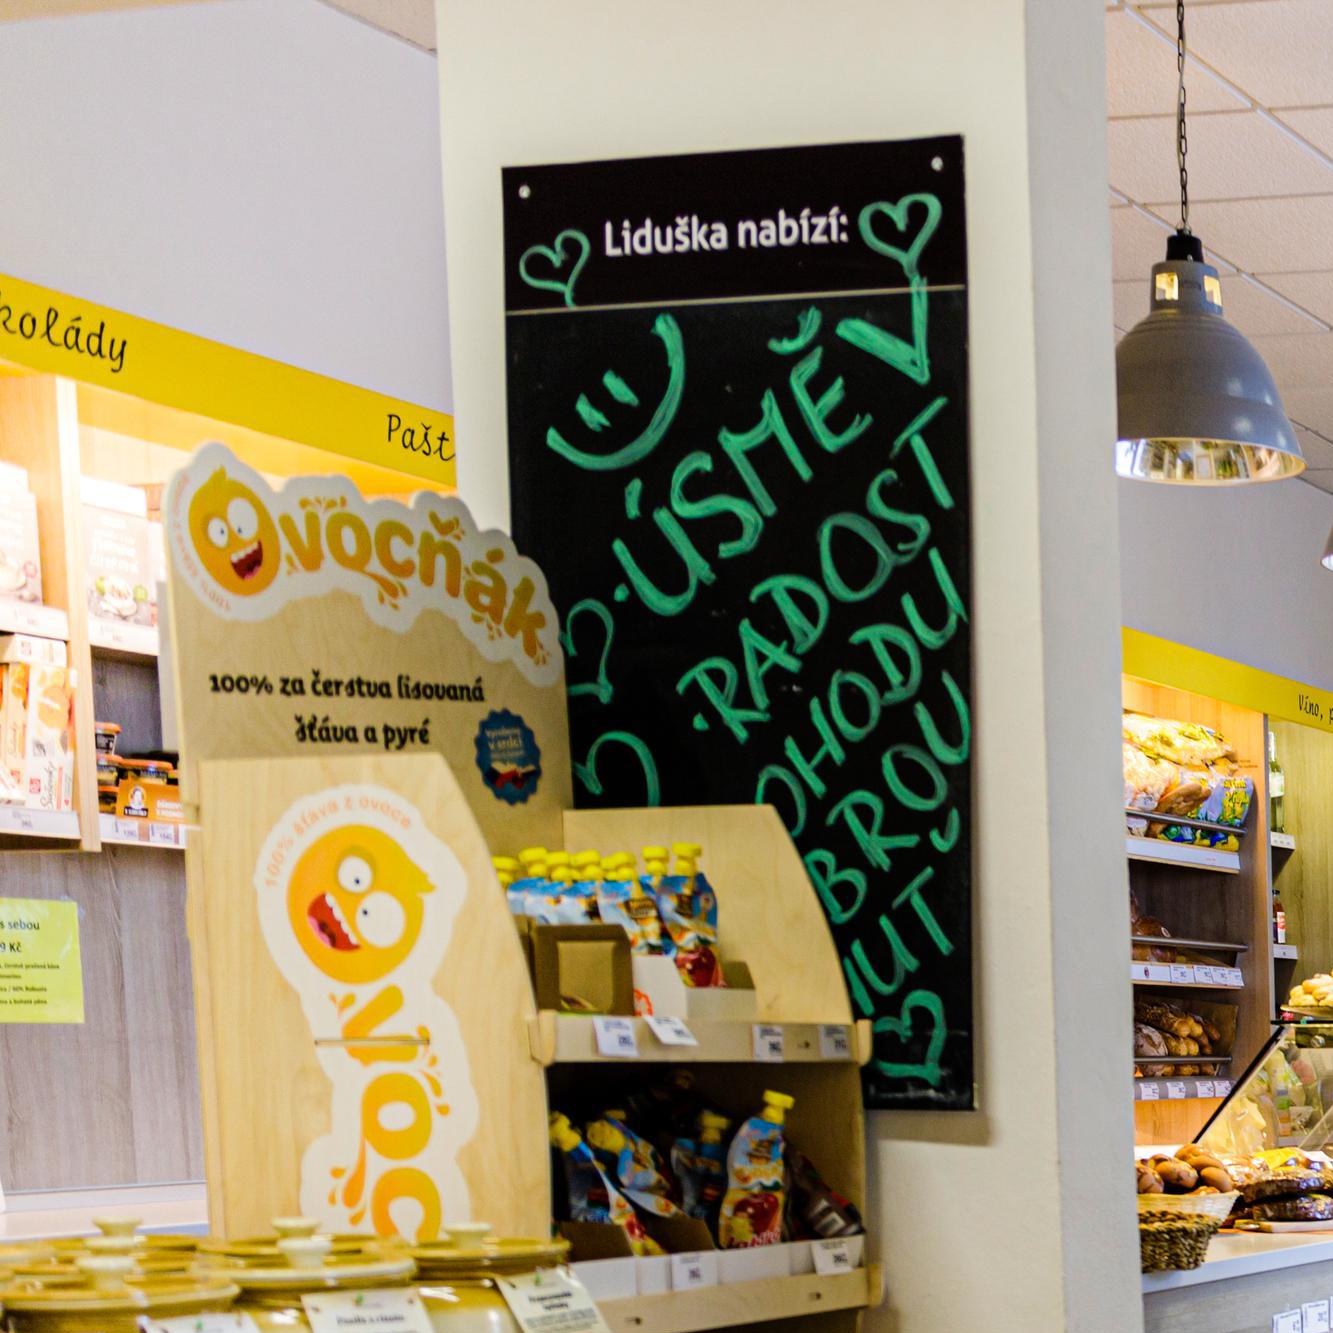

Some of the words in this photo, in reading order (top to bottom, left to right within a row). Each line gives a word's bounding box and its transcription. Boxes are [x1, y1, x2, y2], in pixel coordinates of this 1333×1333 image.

[604, 216, 728, 257] Liduška
[738, 206, 849, 247] nabízí:
[677, 396, 956, 745] RADOST
[209, 673, 273, 696] 100%
[279, 675, 306, 697] za
[397, 674, 485, 703] lisovaná
[1298, 695, 1324, 720] Víno,
[295, 713, 359, 744] šťáva
[363, 724, 379, 743] a
[383, 718, 431, 750] pyré
[358, 796, 414, 831] ovoce
[8, 918, 40, 932] sebou
[9, 940, 22, 954] Kč
